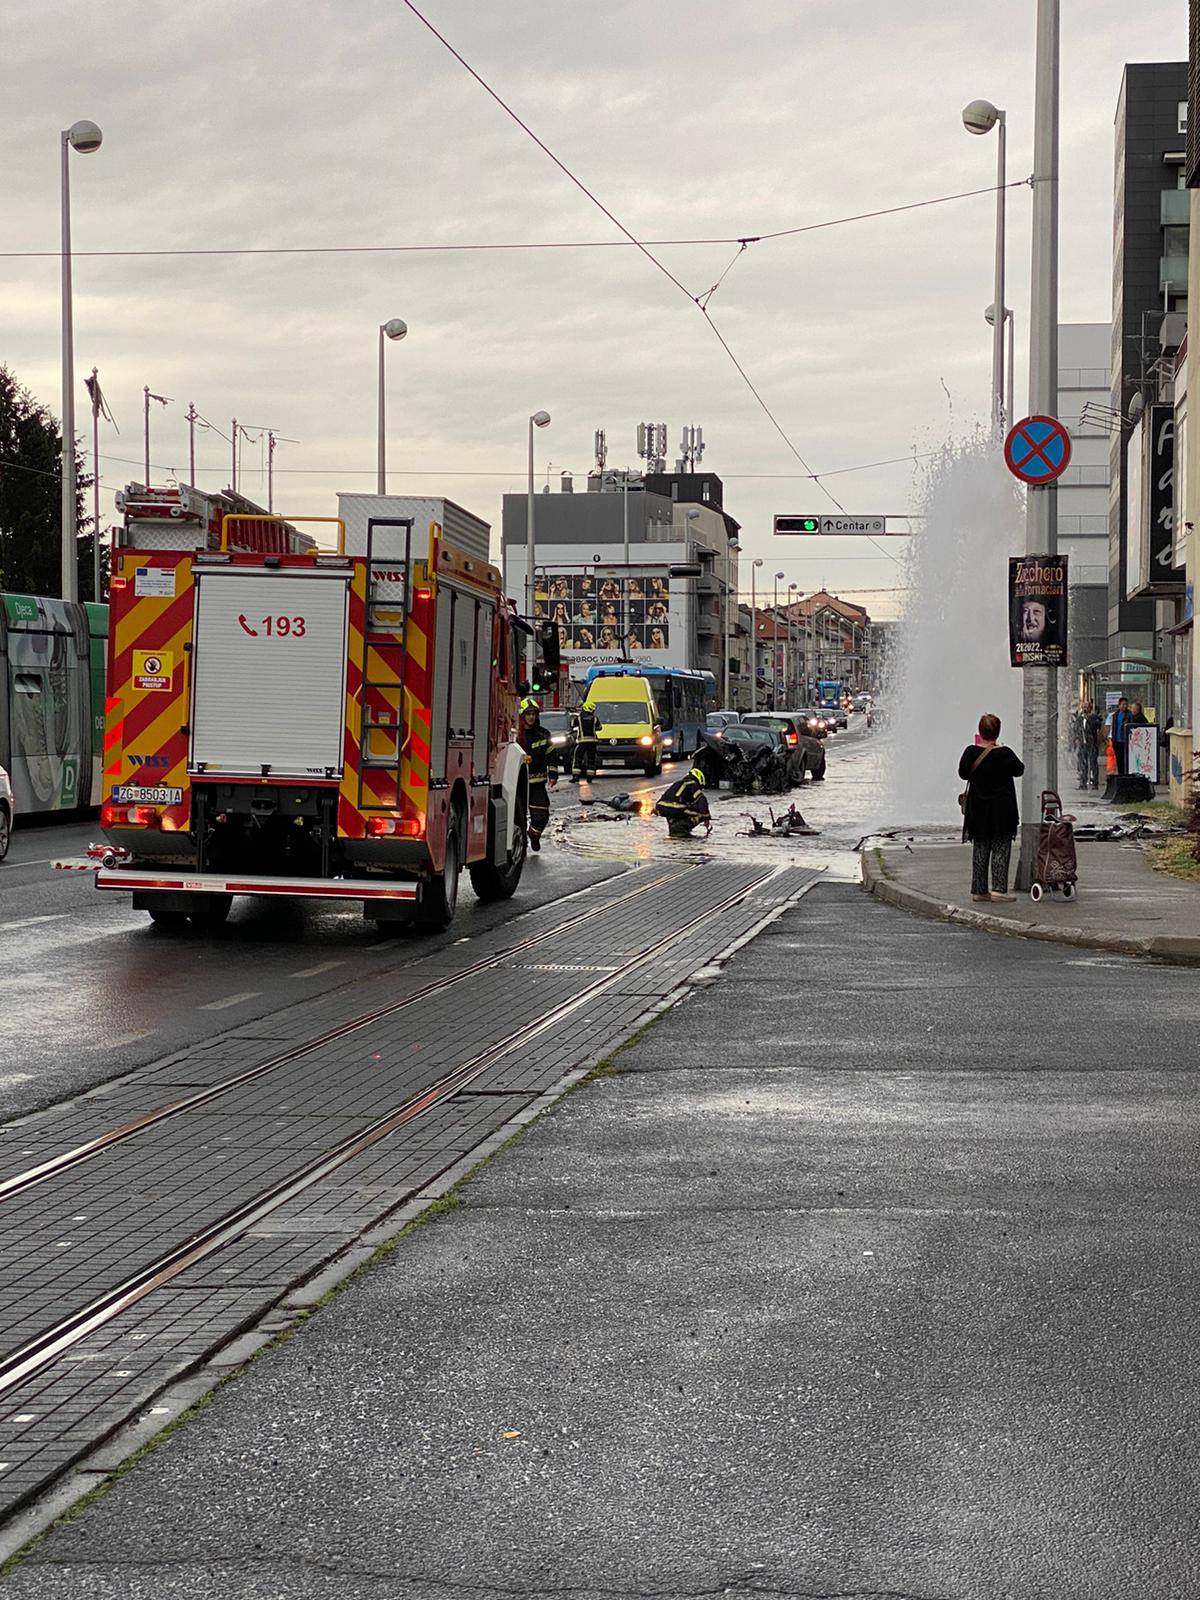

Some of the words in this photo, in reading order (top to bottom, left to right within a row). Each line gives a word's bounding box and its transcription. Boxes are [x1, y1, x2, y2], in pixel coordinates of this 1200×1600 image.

[835, 520, 869, 530] Centar
[262, 616, 306, 637] 193
[127, 754, 170, 769] WISS
[120, 788, 134, 800] ZG
